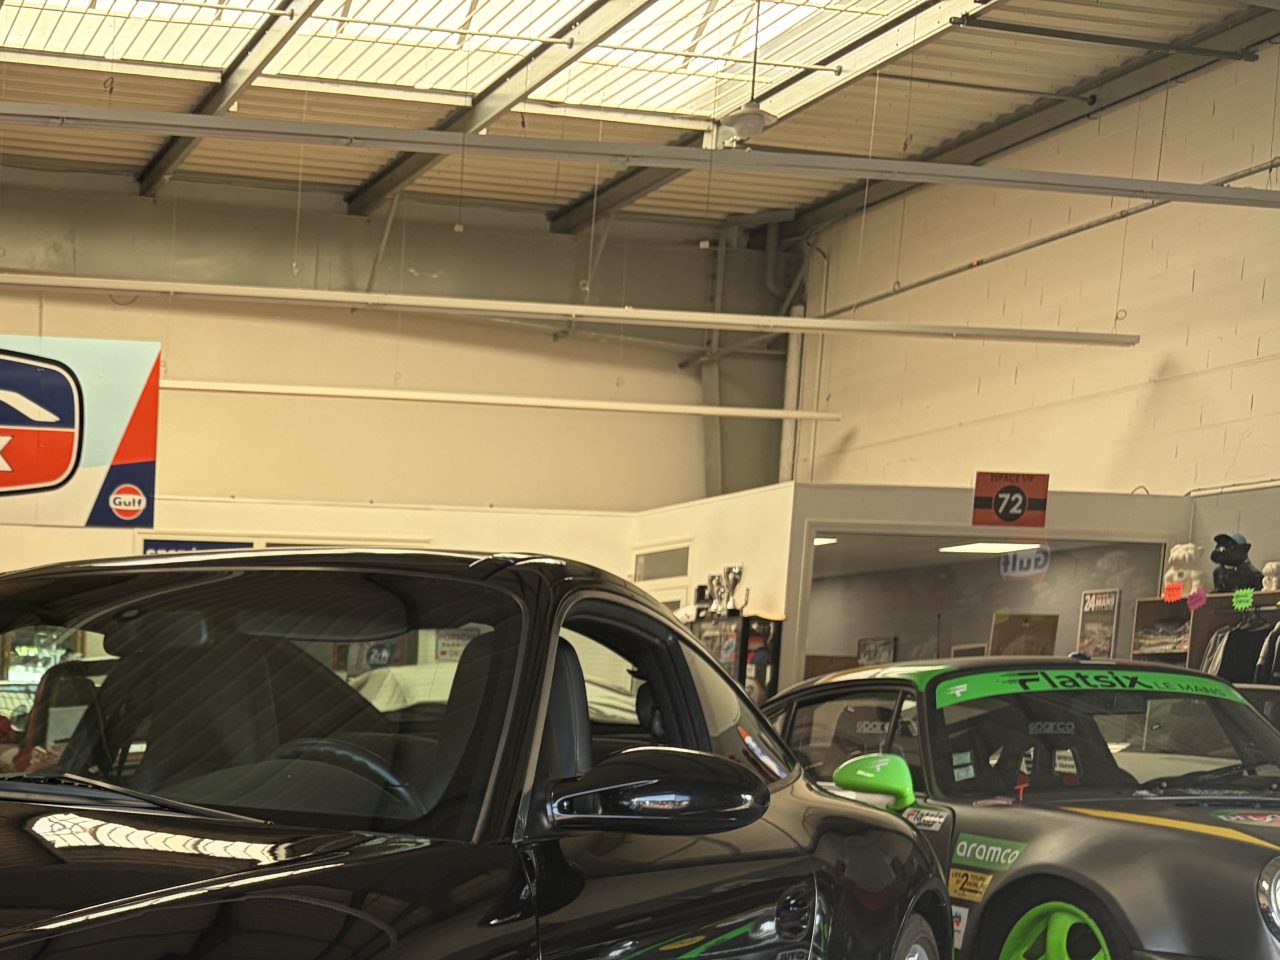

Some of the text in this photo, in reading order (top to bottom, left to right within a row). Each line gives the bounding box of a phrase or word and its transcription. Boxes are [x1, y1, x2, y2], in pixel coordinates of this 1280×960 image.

[112, 496, 143, 508] Gulf
[998, 493, 1023, 514] 72
[1084, 594, 1096, 612] 24
[1004, 671, 1154, 691] Flatsix
[956, 840, 1020, 865] aramco
